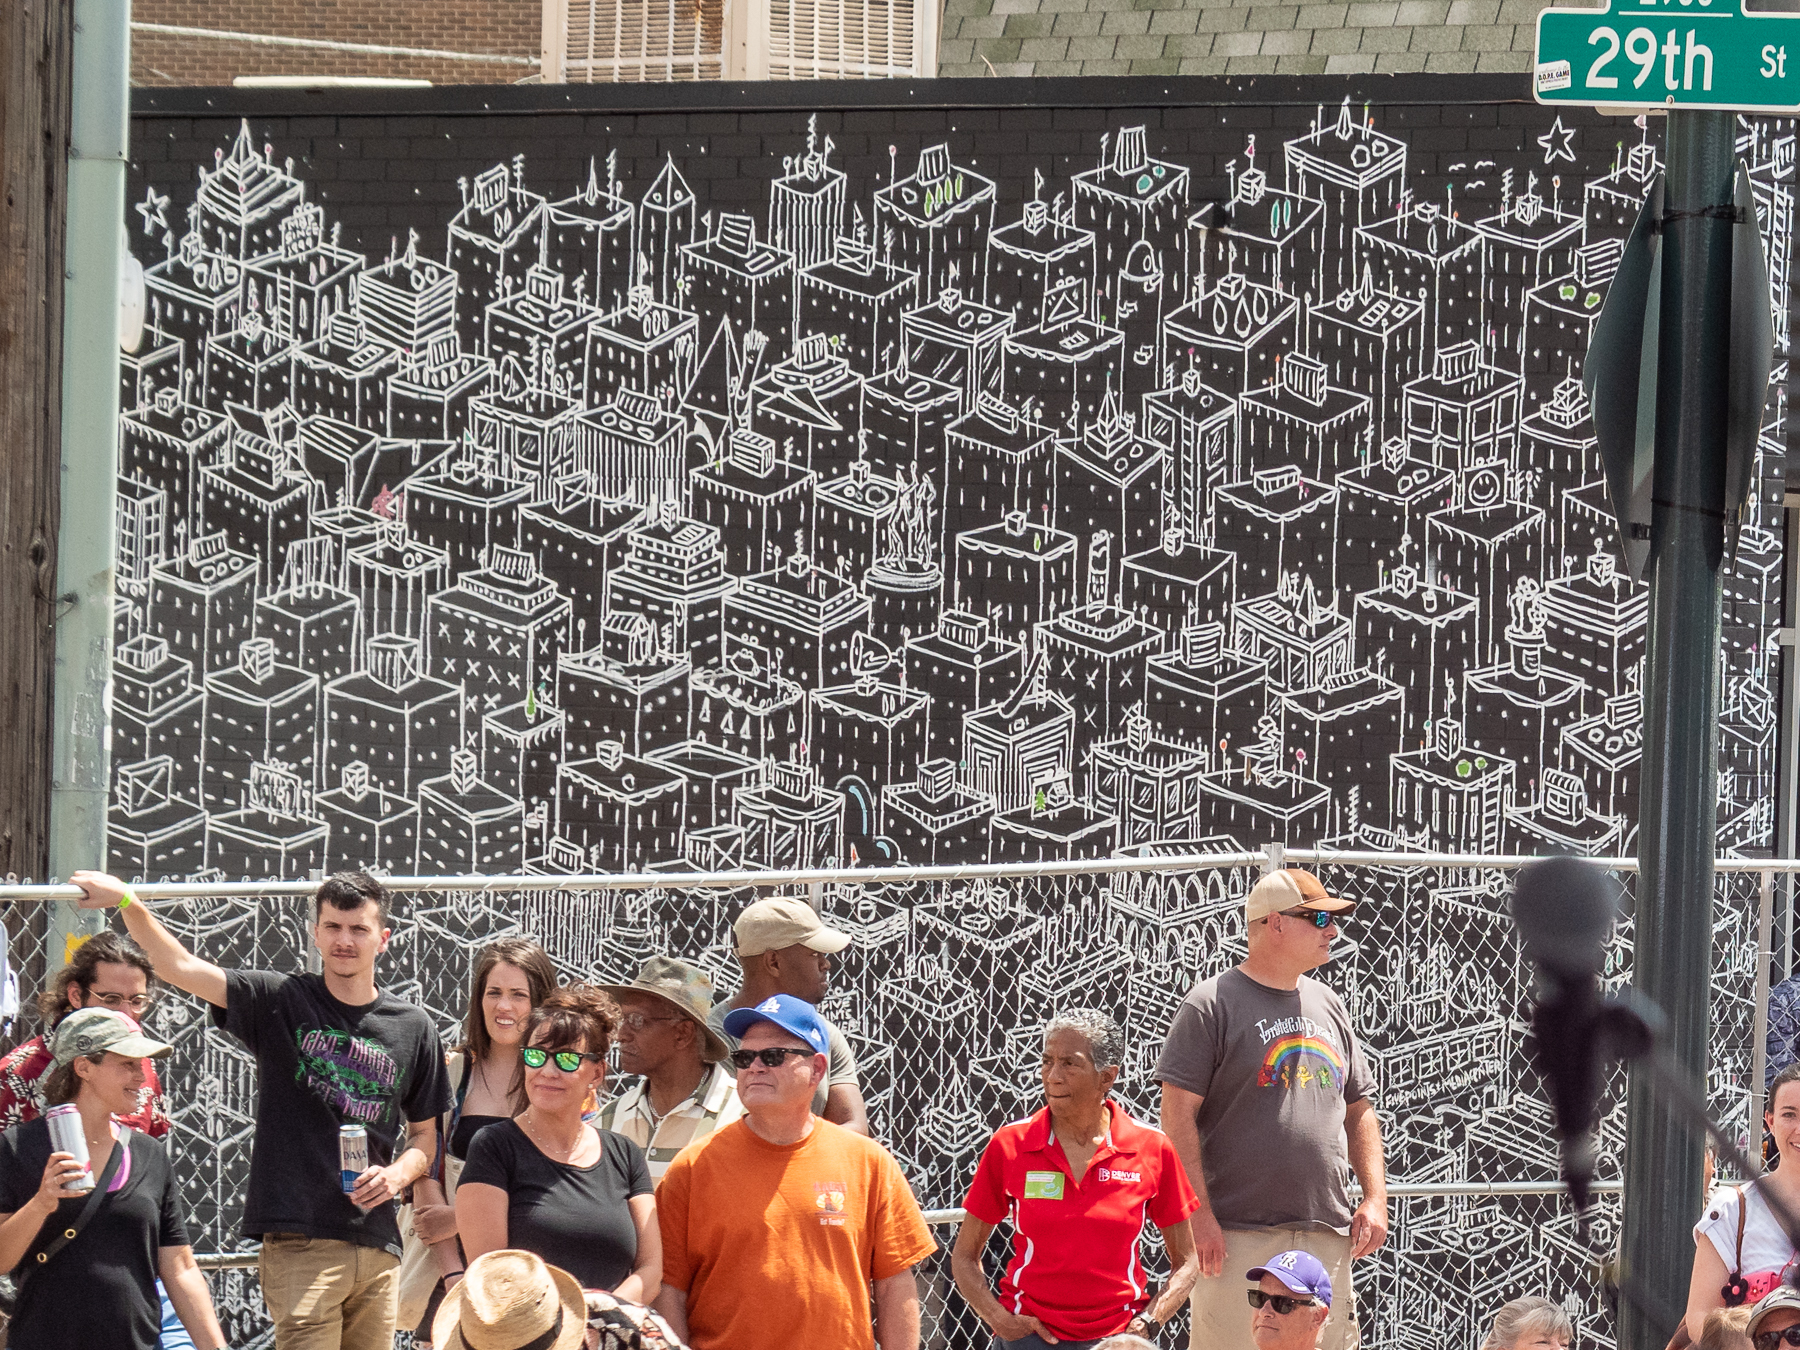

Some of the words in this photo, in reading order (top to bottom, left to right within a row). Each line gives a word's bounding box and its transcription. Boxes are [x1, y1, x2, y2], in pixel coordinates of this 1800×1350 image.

[1585, 26, 1714, 91] 29th
[1759, 44, 1787, 78] St
[1111, 1170, 1141, 1179] DENVER
